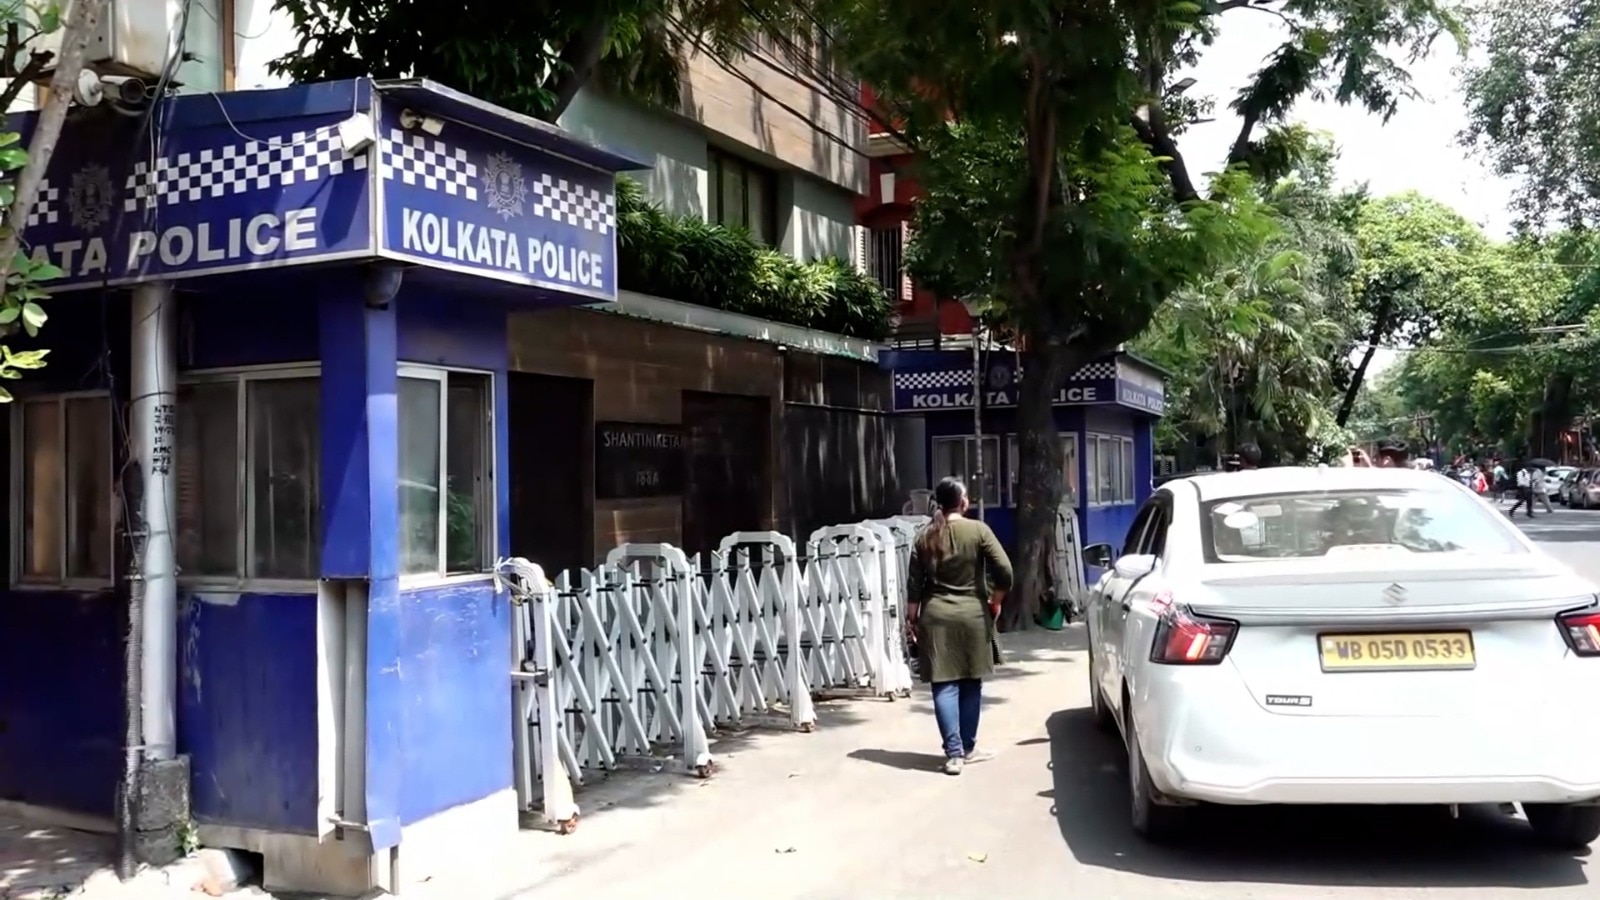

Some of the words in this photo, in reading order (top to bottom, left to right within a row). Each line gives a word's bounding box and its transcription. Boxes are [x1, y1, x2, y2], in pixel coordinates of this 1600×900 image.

[127, 207, 317, 270] POLICE
[403, 207, 522, 271] KOLKATA
[528, 237, 603, 288] POLICE
[1336, 641, 1363, 660] WB
[1368, 640, 1408, 660] 05D
[1413, 638, 1466, 659] 0533
